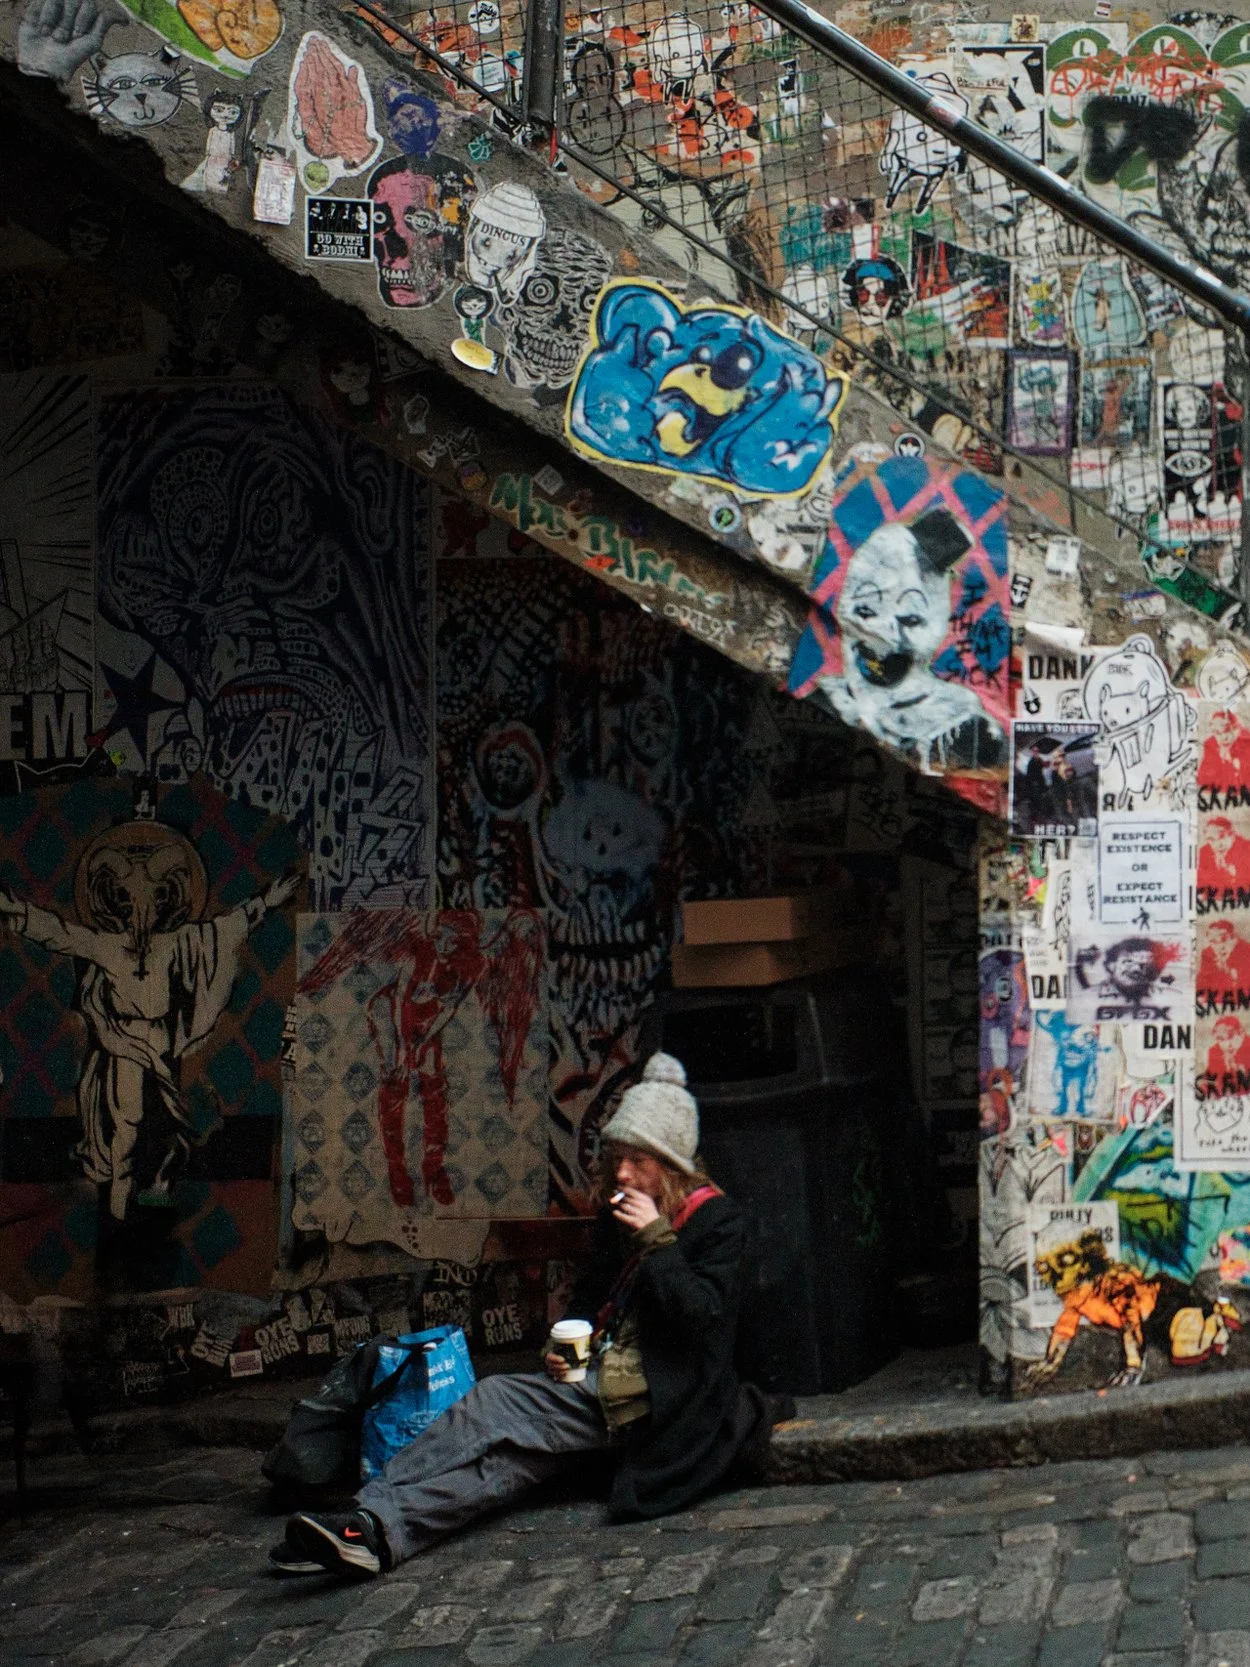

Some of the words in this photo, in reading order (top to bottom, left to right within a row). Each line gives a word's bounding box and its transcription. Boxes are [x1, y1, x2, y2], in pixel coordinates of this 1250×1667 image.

[480, 223, 528, 248] DINGUS
[1034, 823, 1076, 836] HER?
[1111, 831, 1167, 841] RESPECT
[1106, 843, 1173, 854] EXISTENCE
[1131, 862, 1149, 873] OR
[1116, 881, 1163, 892] EXPECT
[1102, 893, 1177, 905] RESISTANCE
[1143, 1024, 1192, 1050] DAN
[482, 1303, 519, 1328] OYE
[254, 1315, 294, 1345] OYE
[484, 1323, 524, 1347] RUNS
[261, 1329, 301, 1365] RUNS
